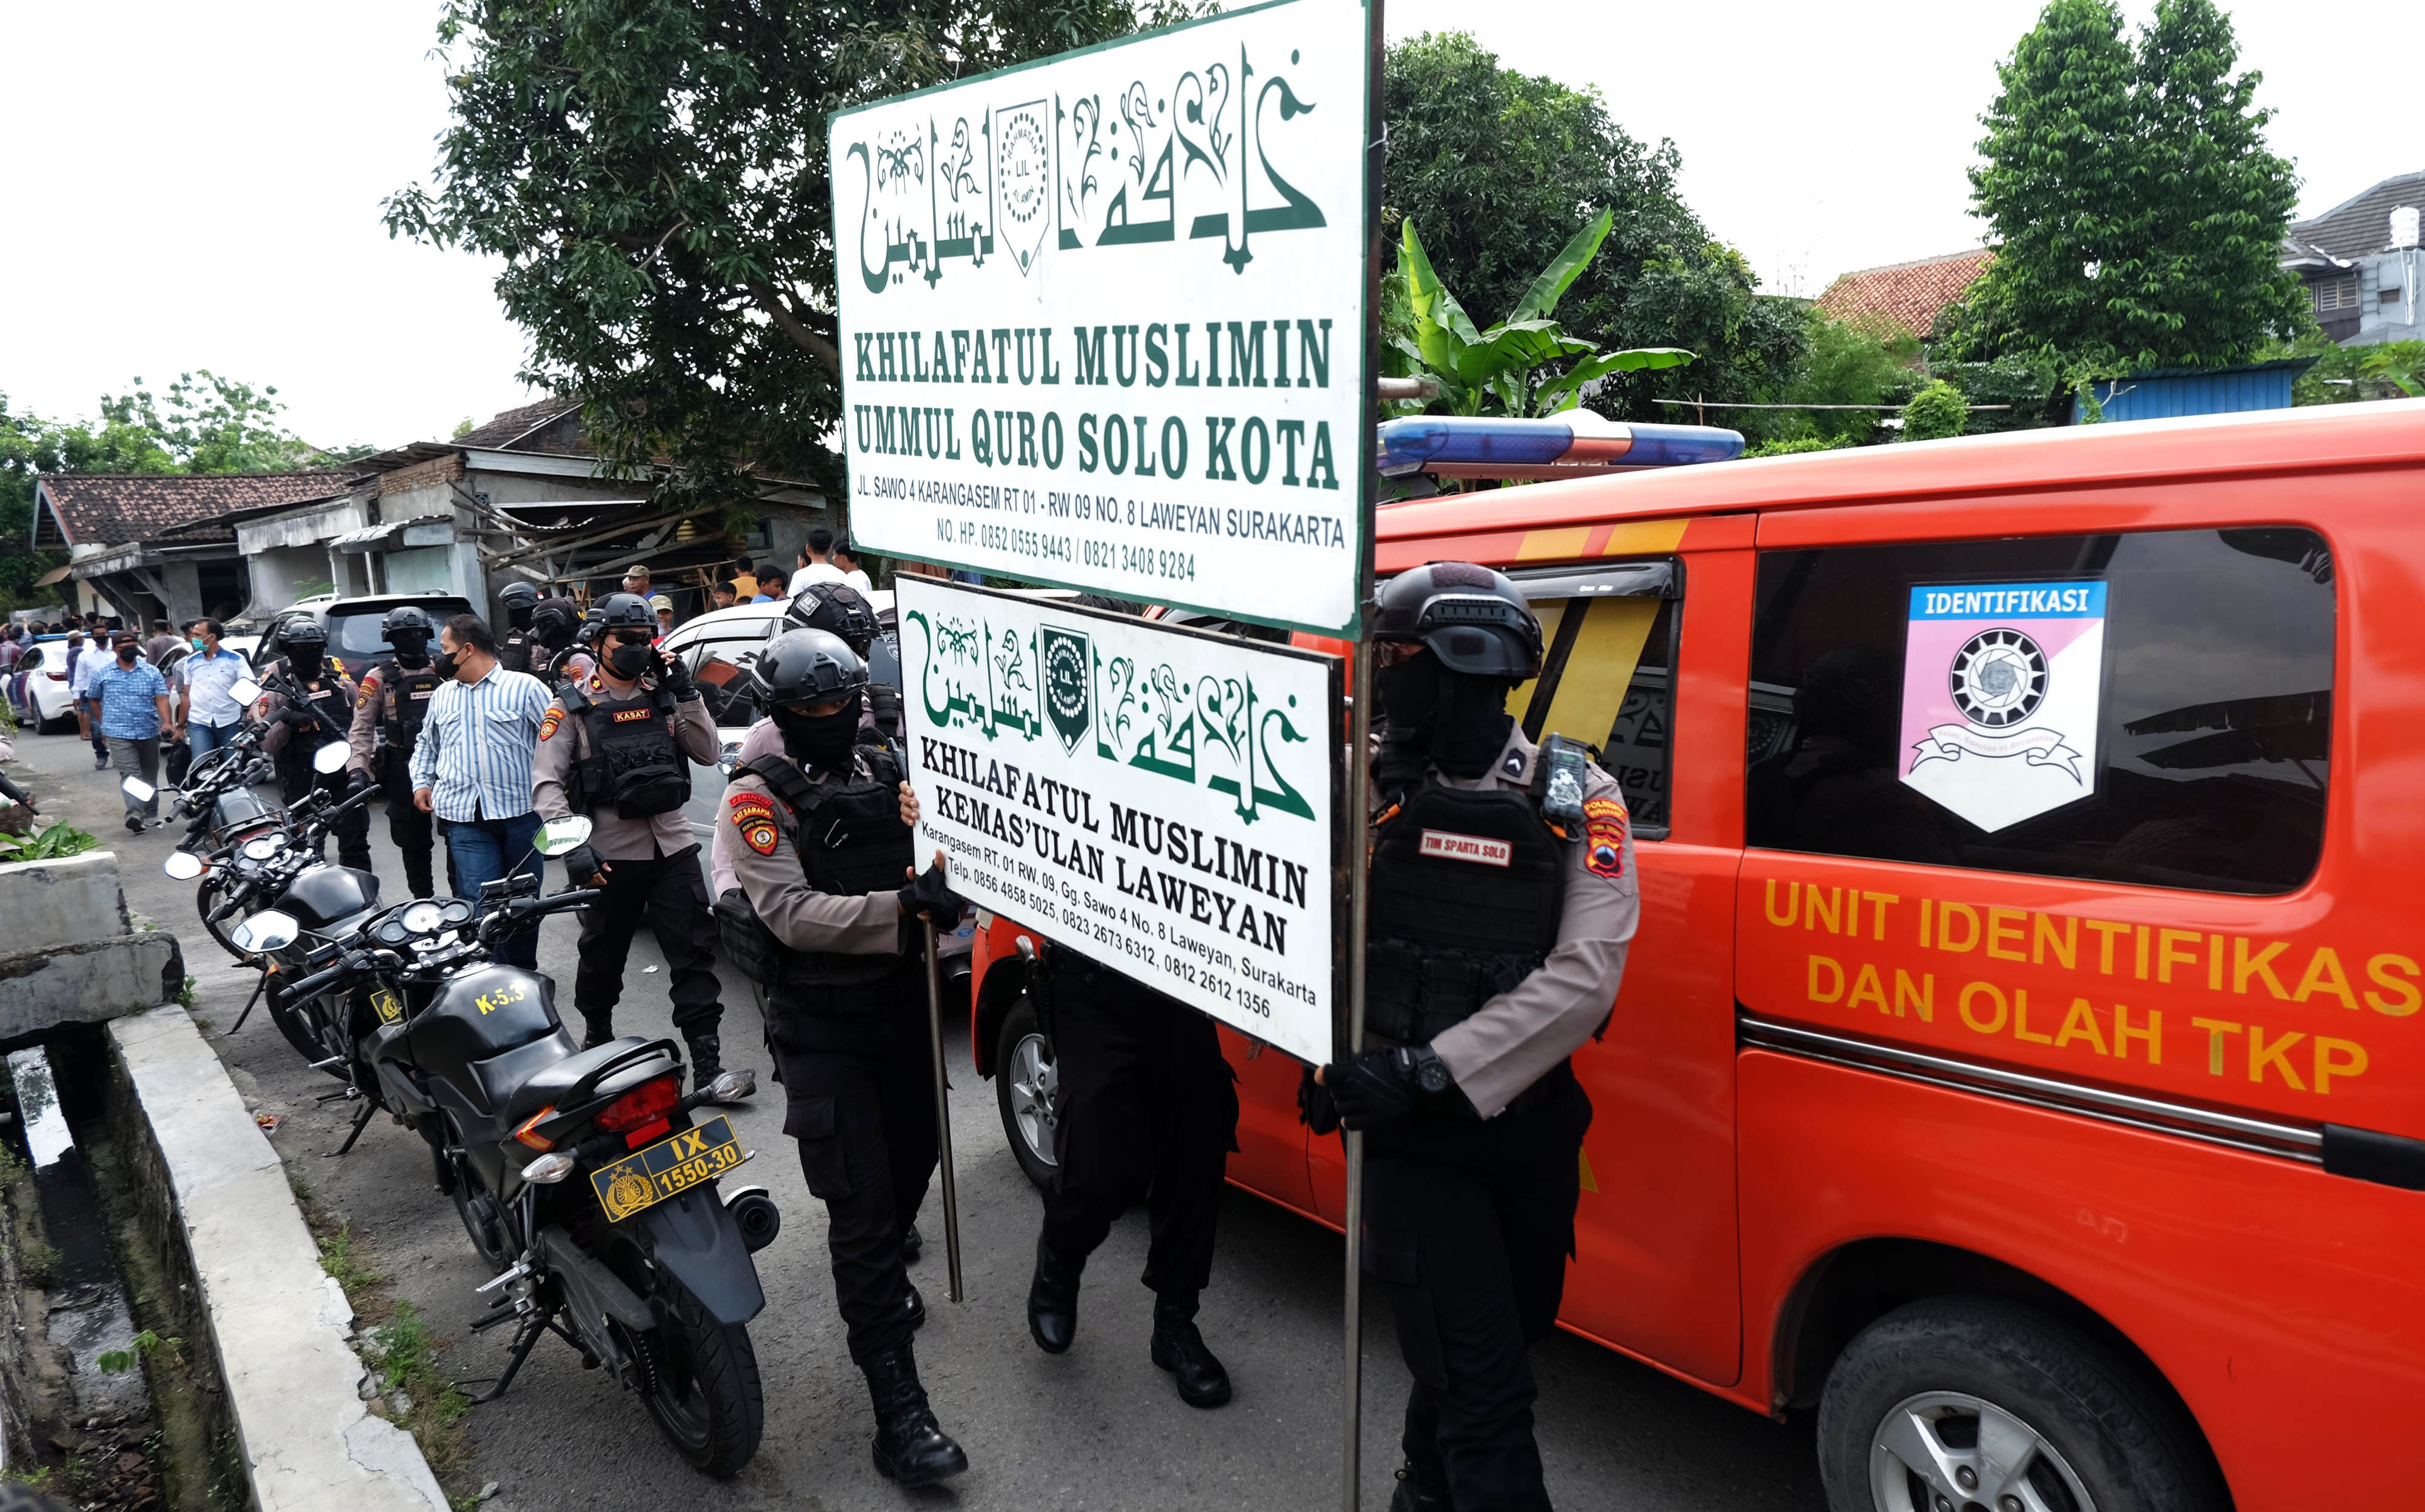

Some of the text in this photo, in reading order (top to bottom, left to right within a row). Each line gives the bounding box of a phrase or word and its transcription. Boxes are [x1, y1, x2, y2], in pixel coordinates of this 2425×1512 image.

[1008, 128, 1038, 159] RAHMATAN
[1015, 159, 1030, 177] LIL
[854, 318, 1333, 389] KHILAFATUL MUSLIMIN
[854, 404, 1339, 490] UMMUL QURO SOLO KOTA
[857, 475, 872, 497] JL.
[874, 476, 906, 500] SAWO
[909, 480, 915, 501] 4
[918, 480, 1000, 510] KARANGASEM
[1004, 487, 1019, 512] RT
[1023, 489, 1035, 514] 01
[1048, 492, 1070, 518] RW
[1075, 493, 1091, 520] 09
[1096, 495, 1122, 524] NO.
[1127, 500, 1135, 526] 8
[1141, 501, 1220, 535] LAWEYAN
[1226, 508, 1345, 549] SURAKARTA
[937, 518, 955, 543] NO.
[960, 522, 977, 546] HP.
[982, 524, 1008, 551] 0852
[1012, 528, 1038, 557] 0555
[1042, 534, 1071, 563] 9443
[1084, 540, 1115, 569] 0821
[1122, 544, 1154, 575] 3408
[1160, 550, 1195, 581] 9284
[802, 596, 816, 608] AB+
[1925, 589, 2089, 614] IDENTIFIKASI
[1052, 649, 1079, 674] RAHMATAN
[1060, 669, 1073, 686] LIL
[616, 711, 646, 721] KASAT
[920, 735, 1308, 909] KHILAFATUL MUSLIMIN
[935, 784, 1287, 956] KEMAS'ULAN LAWEYAN
[1426, 837, 1506, 859] TIM SPARTA SOLO
[922, 820, 1316, 1006] Karangasem RT. 01 RW. 09, Gg. Sawo 4 No. 8 Laweyan, Surakarta
[1764, 878, 1899, 940] UNIT
[948, 856, 1270, 1018] Telp. 0856 4858 5025, 0823 2673 6312, 0812 2612 1356
[475, 983, 525, 1015] K-5.3
[1808, 954, 2369, 1096] DAN OLAH TKP
[670, 1128, 709, 1161] IX
[660, 1145, 737, 1193] 1550-30
